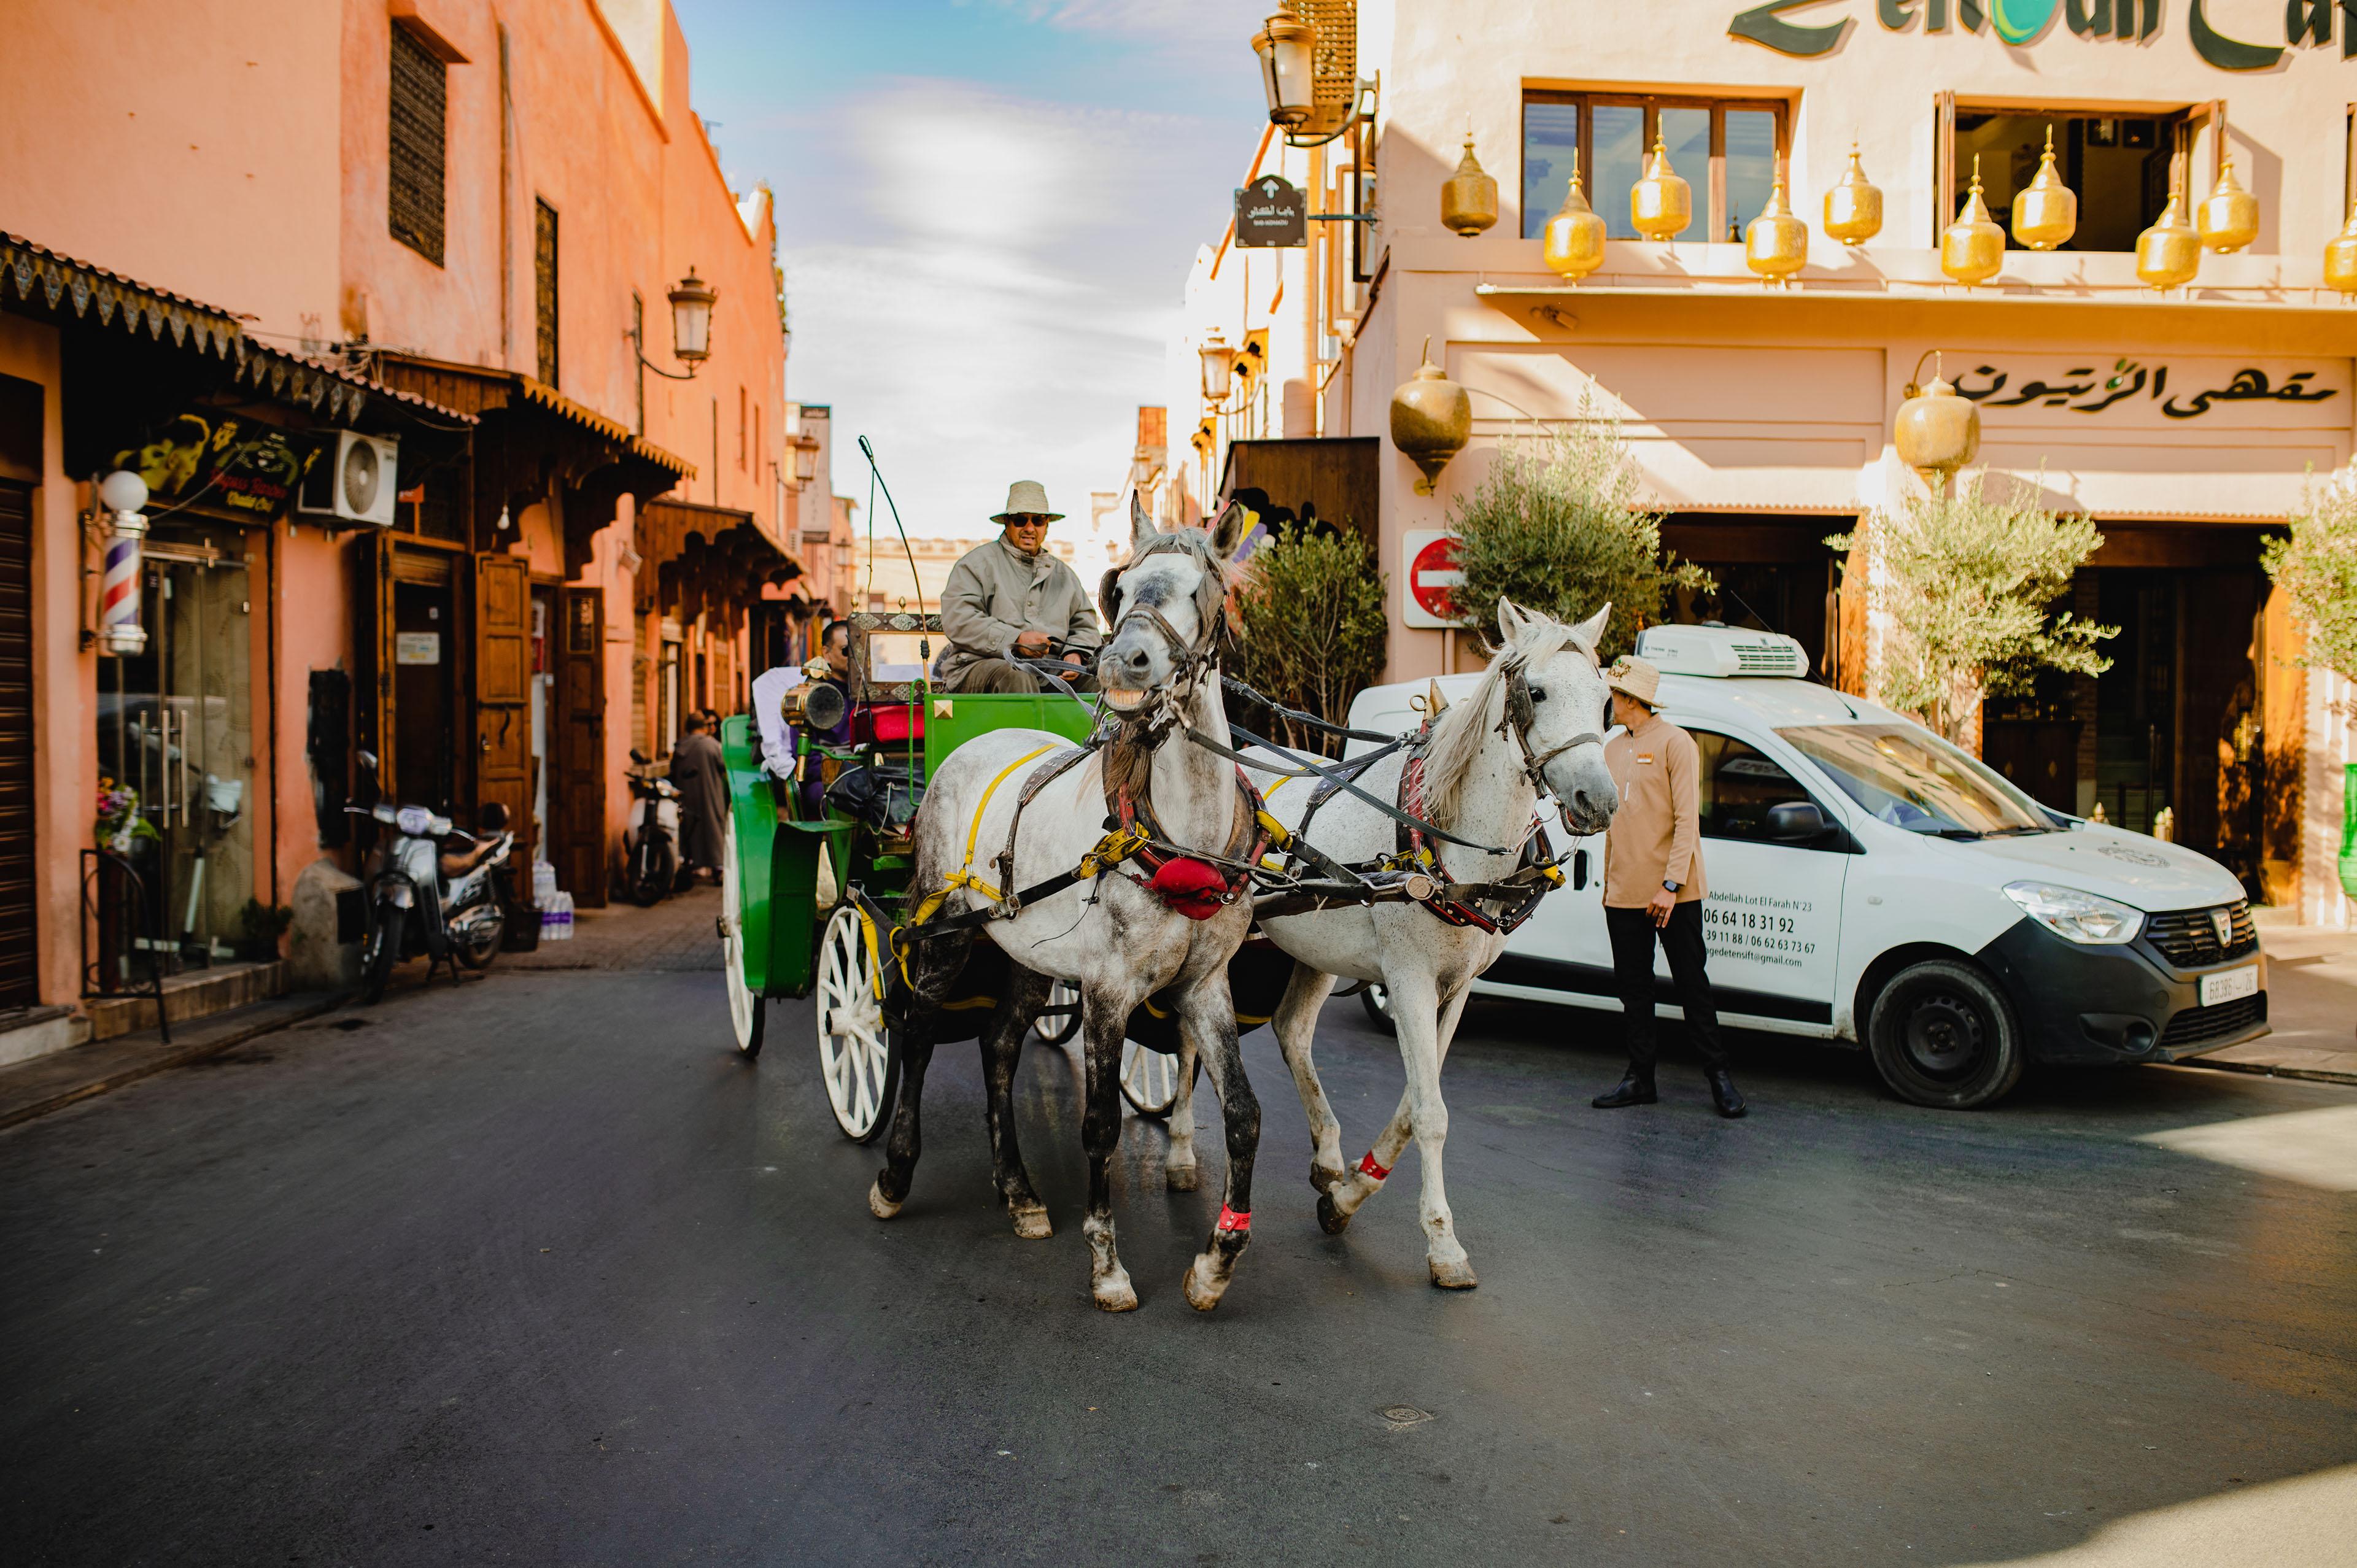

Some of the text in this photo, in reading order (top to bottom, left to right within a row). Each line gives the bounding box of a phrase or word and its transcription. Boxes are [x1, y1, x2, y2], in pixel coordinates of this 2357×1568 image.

[2161, 368, 2339, 419] مقهى
[1709, 891, 1743, 903] Abdellah
[1745, 895, 1757, 905] Lot
[1760, 897, 1767, 906] El
[1769, 898, 1790, 909] Farah
[1704, 908, 1794, 933] 06 64 18 31 92
[1706, 930, 1717, 941] 39
[1720, 932, 1728, 942] 11
[1732, 933, 1743, 944] 88
[1751, 936, 1762, 947] 06
[1765, 938, 1775, 949] 62
[1778, 940, 1788, 951] 63
[1792, 941, 1802, 952] 73
[1805, 943, 1815, 954] 67
